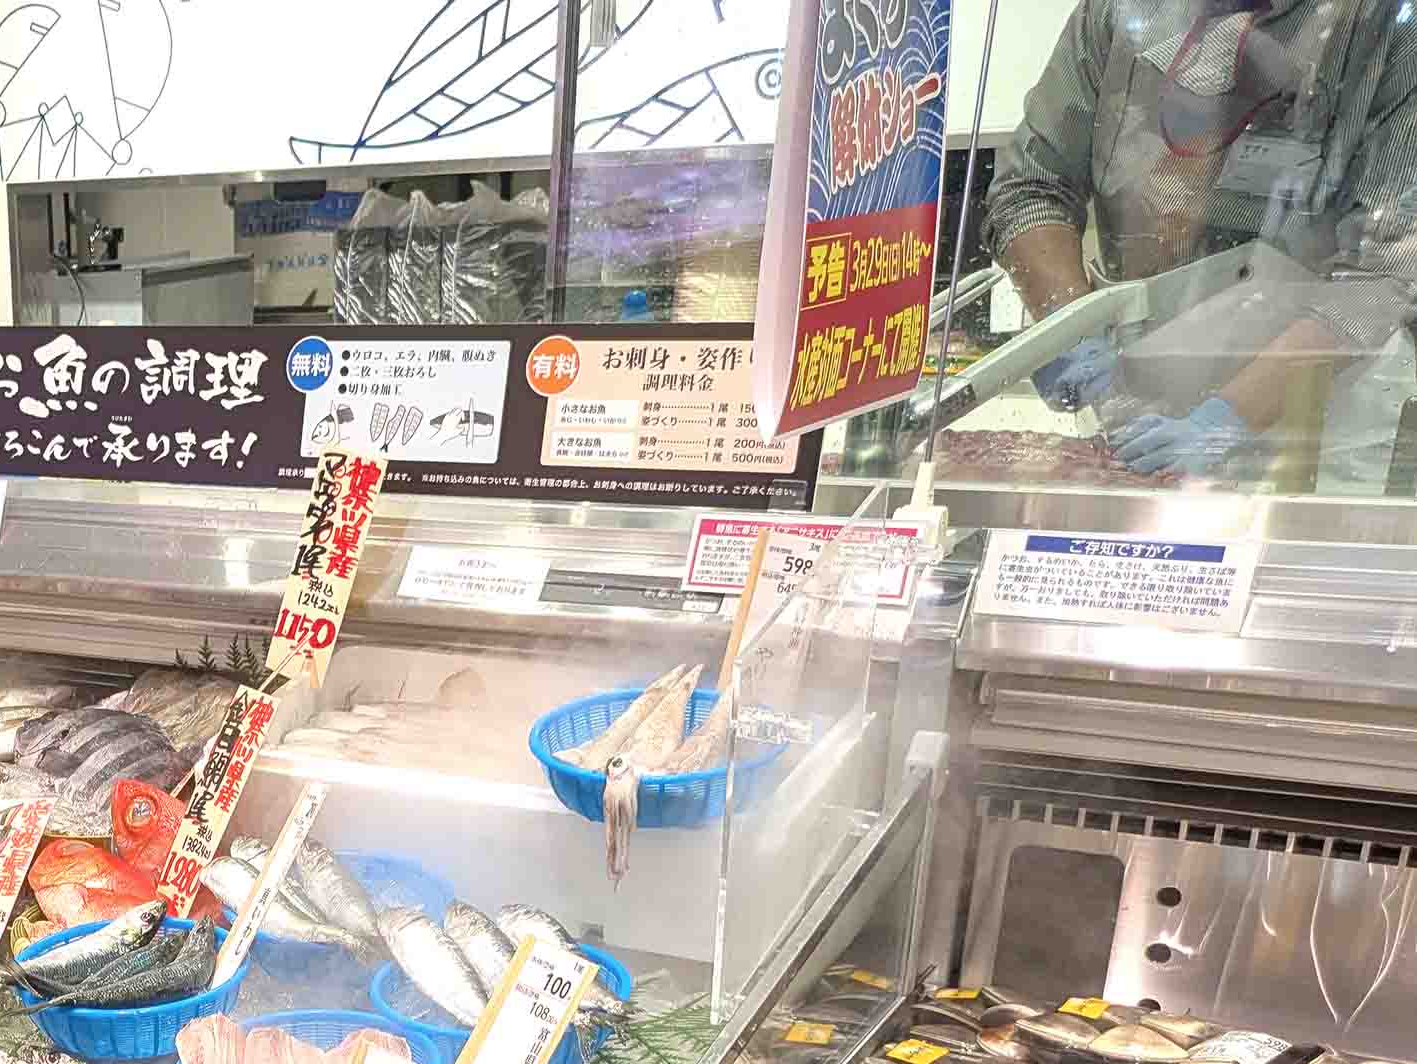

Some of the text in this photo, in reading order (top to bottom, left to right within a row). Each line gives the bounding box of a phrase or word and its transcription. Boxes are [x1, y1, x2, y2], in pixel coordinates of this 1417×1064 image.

[830, 66, 942, 194] 解体ショー
[807, 240, 845, 303] 予告
[292, 352, 331, 377] 無料
[532, 352, 578, 380] 有料
[642, 373, 715, 392] 調理料金
[561, 403, 606, 415] 小さなお魚
[557, 437, 602, 448] 大きなお魚
[1069, 538, 1175, 560] ご存知ですか?
